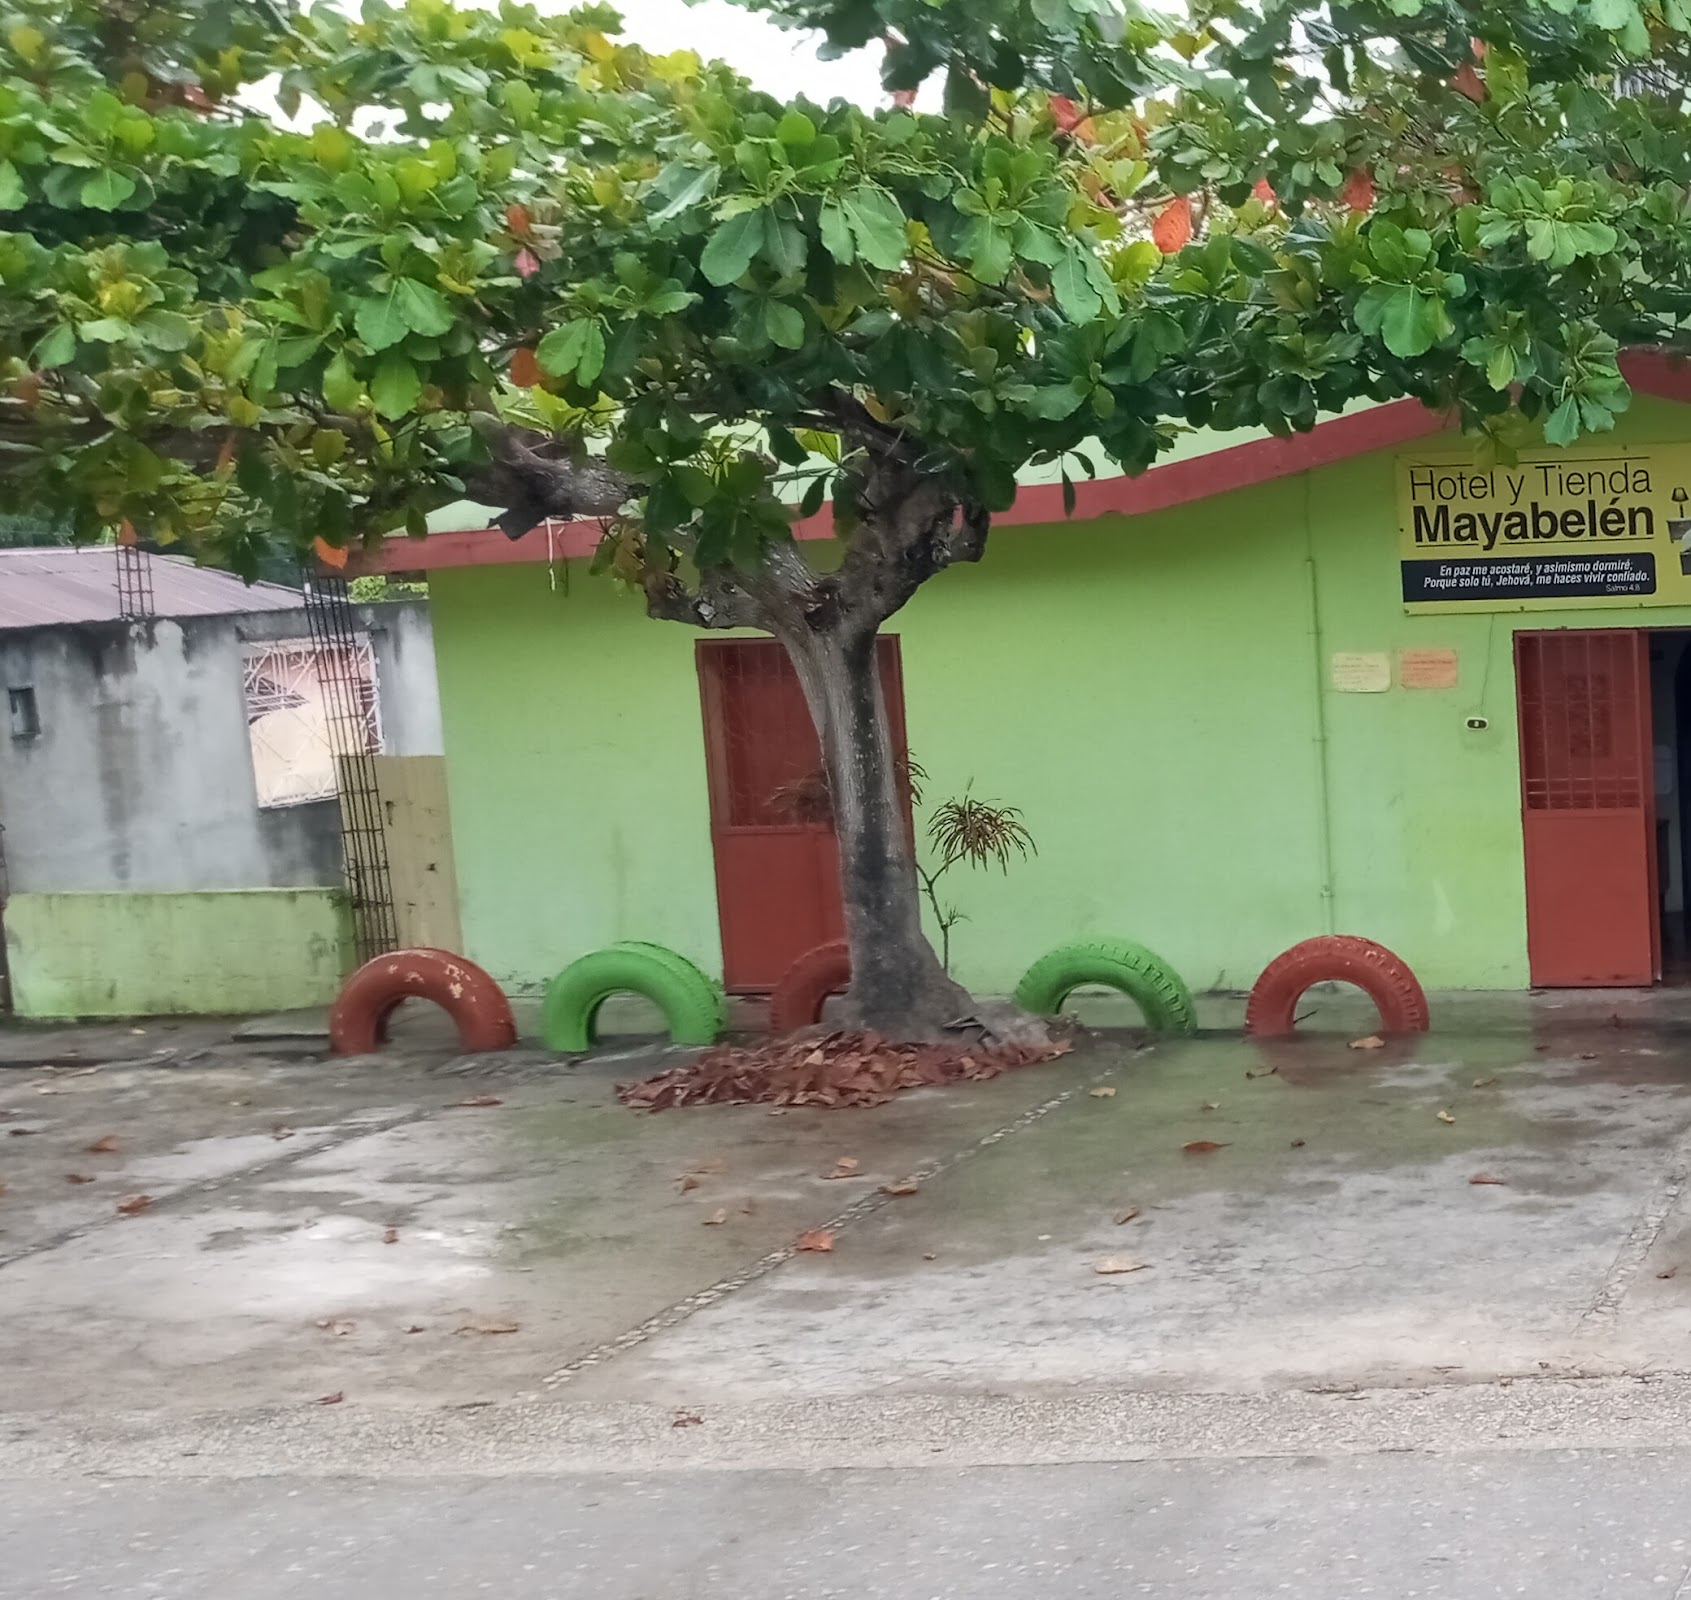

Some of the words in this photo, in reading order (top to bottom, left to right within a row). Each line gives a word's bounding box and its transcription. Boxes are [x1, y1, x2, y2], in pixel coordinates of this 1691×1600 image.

[1409, 468, 1495, 501] Hotel
[1506, 474, 1525, 506] y
[1535, 461, 1653, 497] Tienda
[1413, 496, 1655, 552] Mayabelén
[1440, 565, 1452, 576] En
[1453, 565, 1471, 577] paz
[1472, 565, 1488, 576] me
[1489, 562, 1533, 575] acostaré,
[1535, 564, 1542, 575] y
[1543, 561, 1591, 574] asimismo
[1423, 577, 1457, 590] Porque
[1459, 575, 1480, 587] solo
[1481, 575, 1494, 588] tú,
[1495, 574, 1533, 588] Jehová,
[1535, 575, 1552, 585] me
[1553, 573, 1582, 585] haces
[1583, 571, 1605, 583] vivir
[1606, 570, 1650, 582] confiado.
[1605, 584, 1628, 593] Salmo
